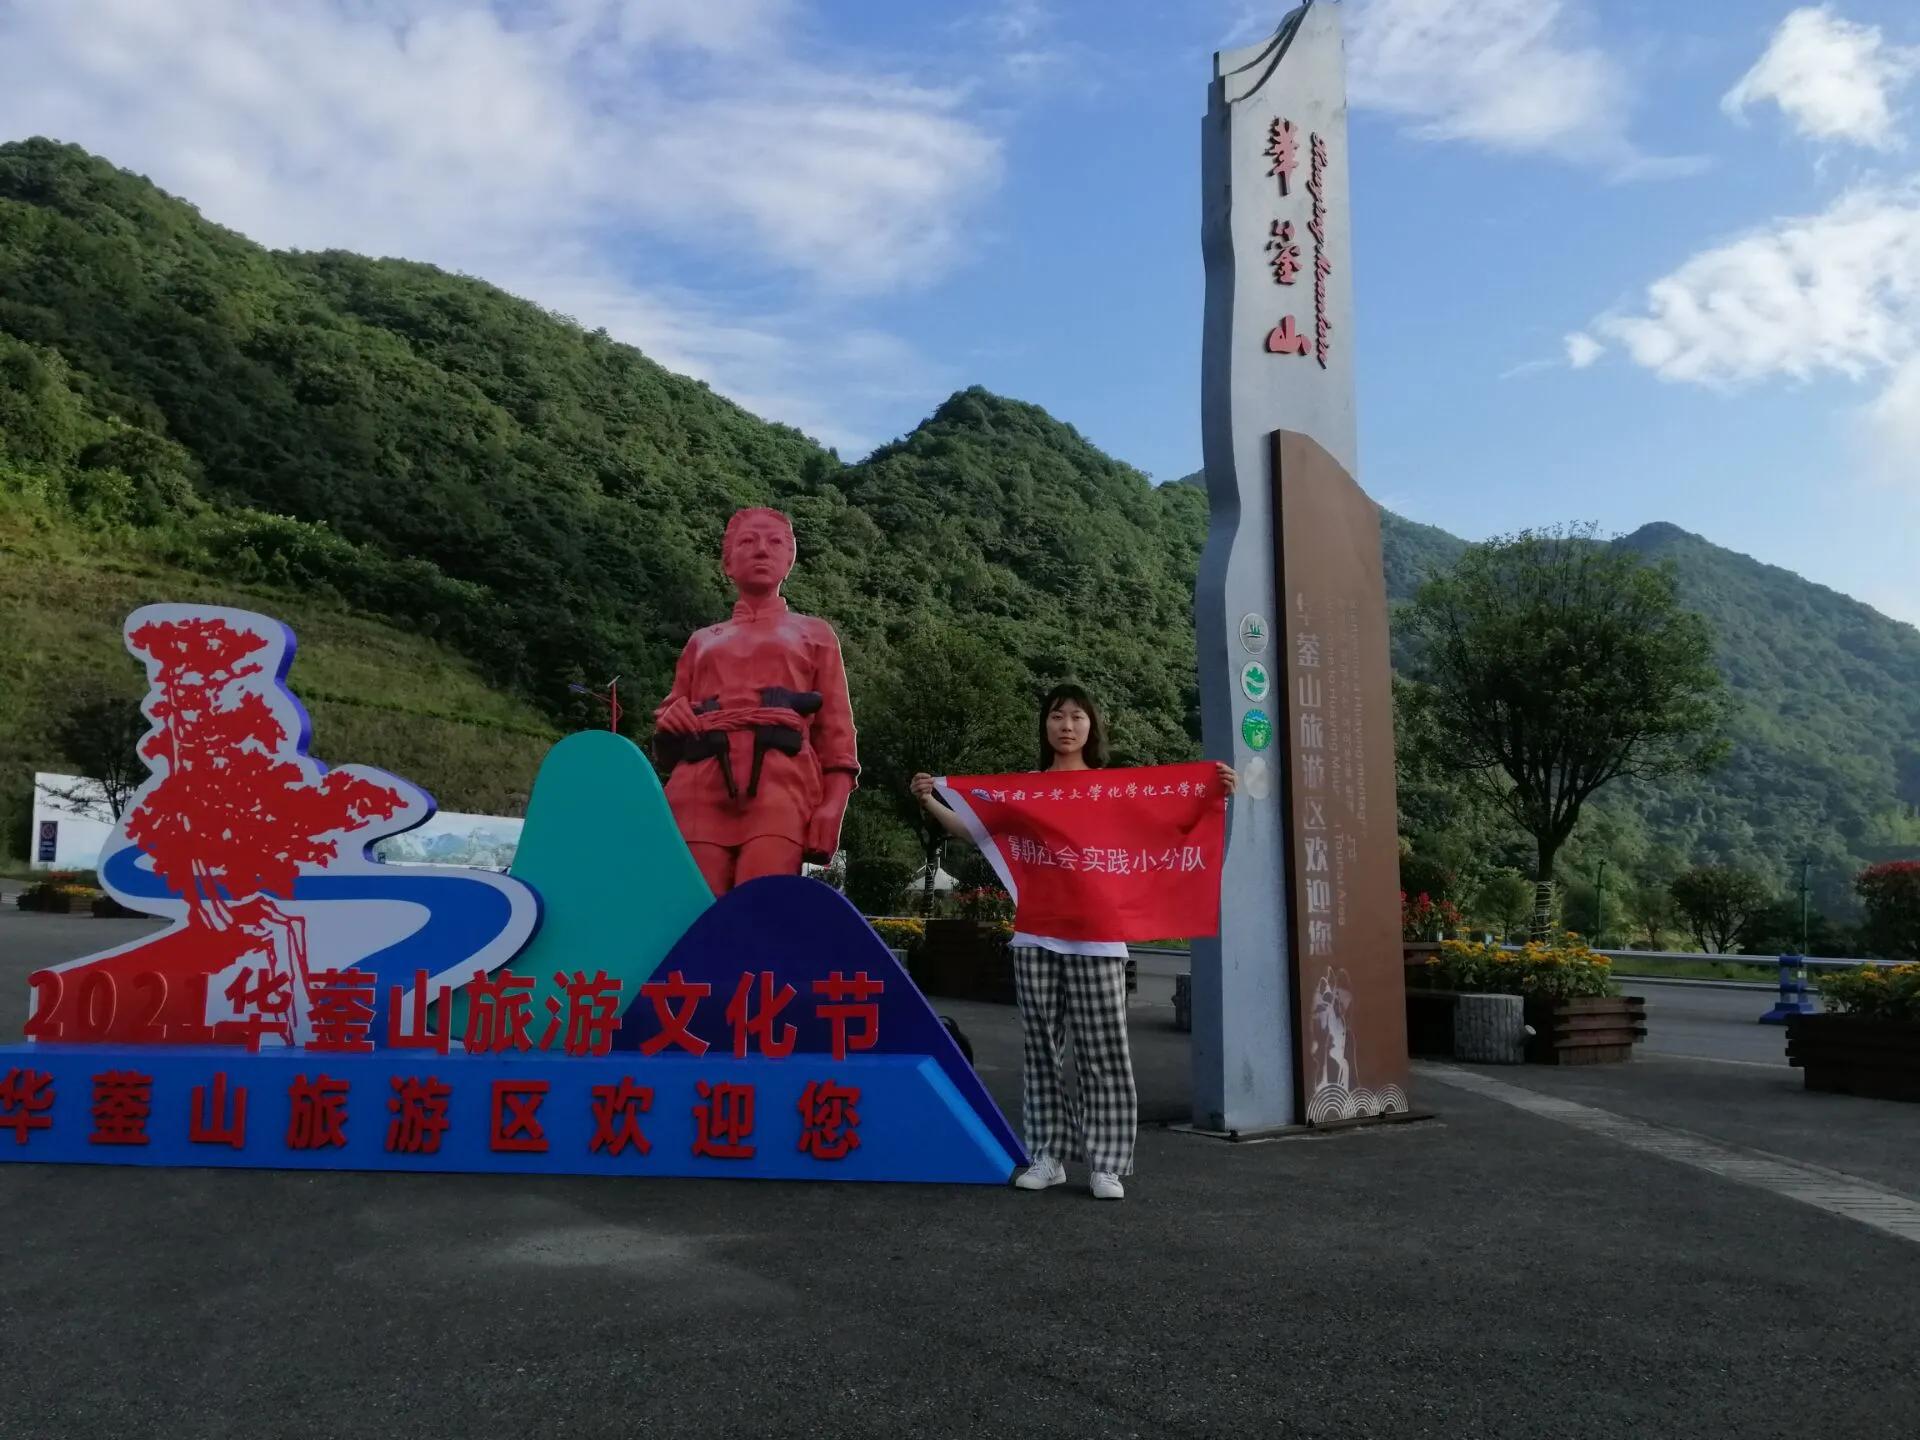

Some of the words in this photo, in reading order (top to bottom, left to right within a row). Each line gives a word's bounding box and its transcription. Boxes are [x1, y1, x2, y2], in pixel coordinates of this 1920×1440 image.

[0, 1067, 862, 1159] 华蓥山旅游区欢迎您
